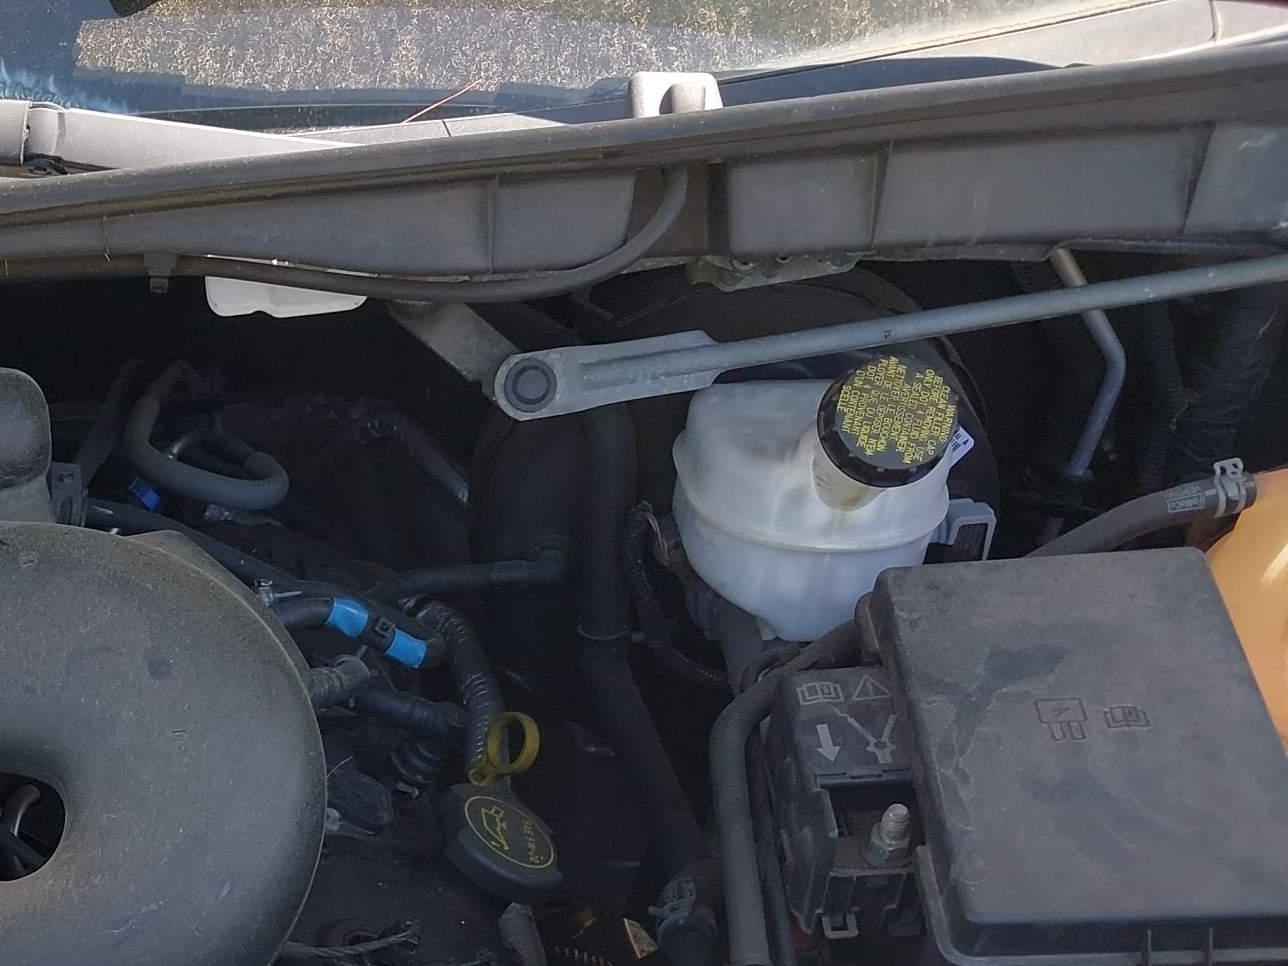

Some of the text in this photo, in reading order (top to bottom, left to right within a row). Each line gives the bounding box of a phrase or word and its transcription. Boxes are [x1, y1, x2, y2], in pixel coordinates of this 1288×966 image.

[865, 365, 877, 380] DOT
[885, 356, 900, 378] AVANT
[882, 380, 893, 390] DE
[923, 369, 936, 388] ONLY
[929, 376, 944, 403] BEFORE
[879, 392, 889, 402] LE
[907, 381, 922, 410] SEALED
[841, 389, 860, 433] CONTENANT
[876, 417, 893, 452] BOUCHON
[902, 442, 916, 464] FROM
